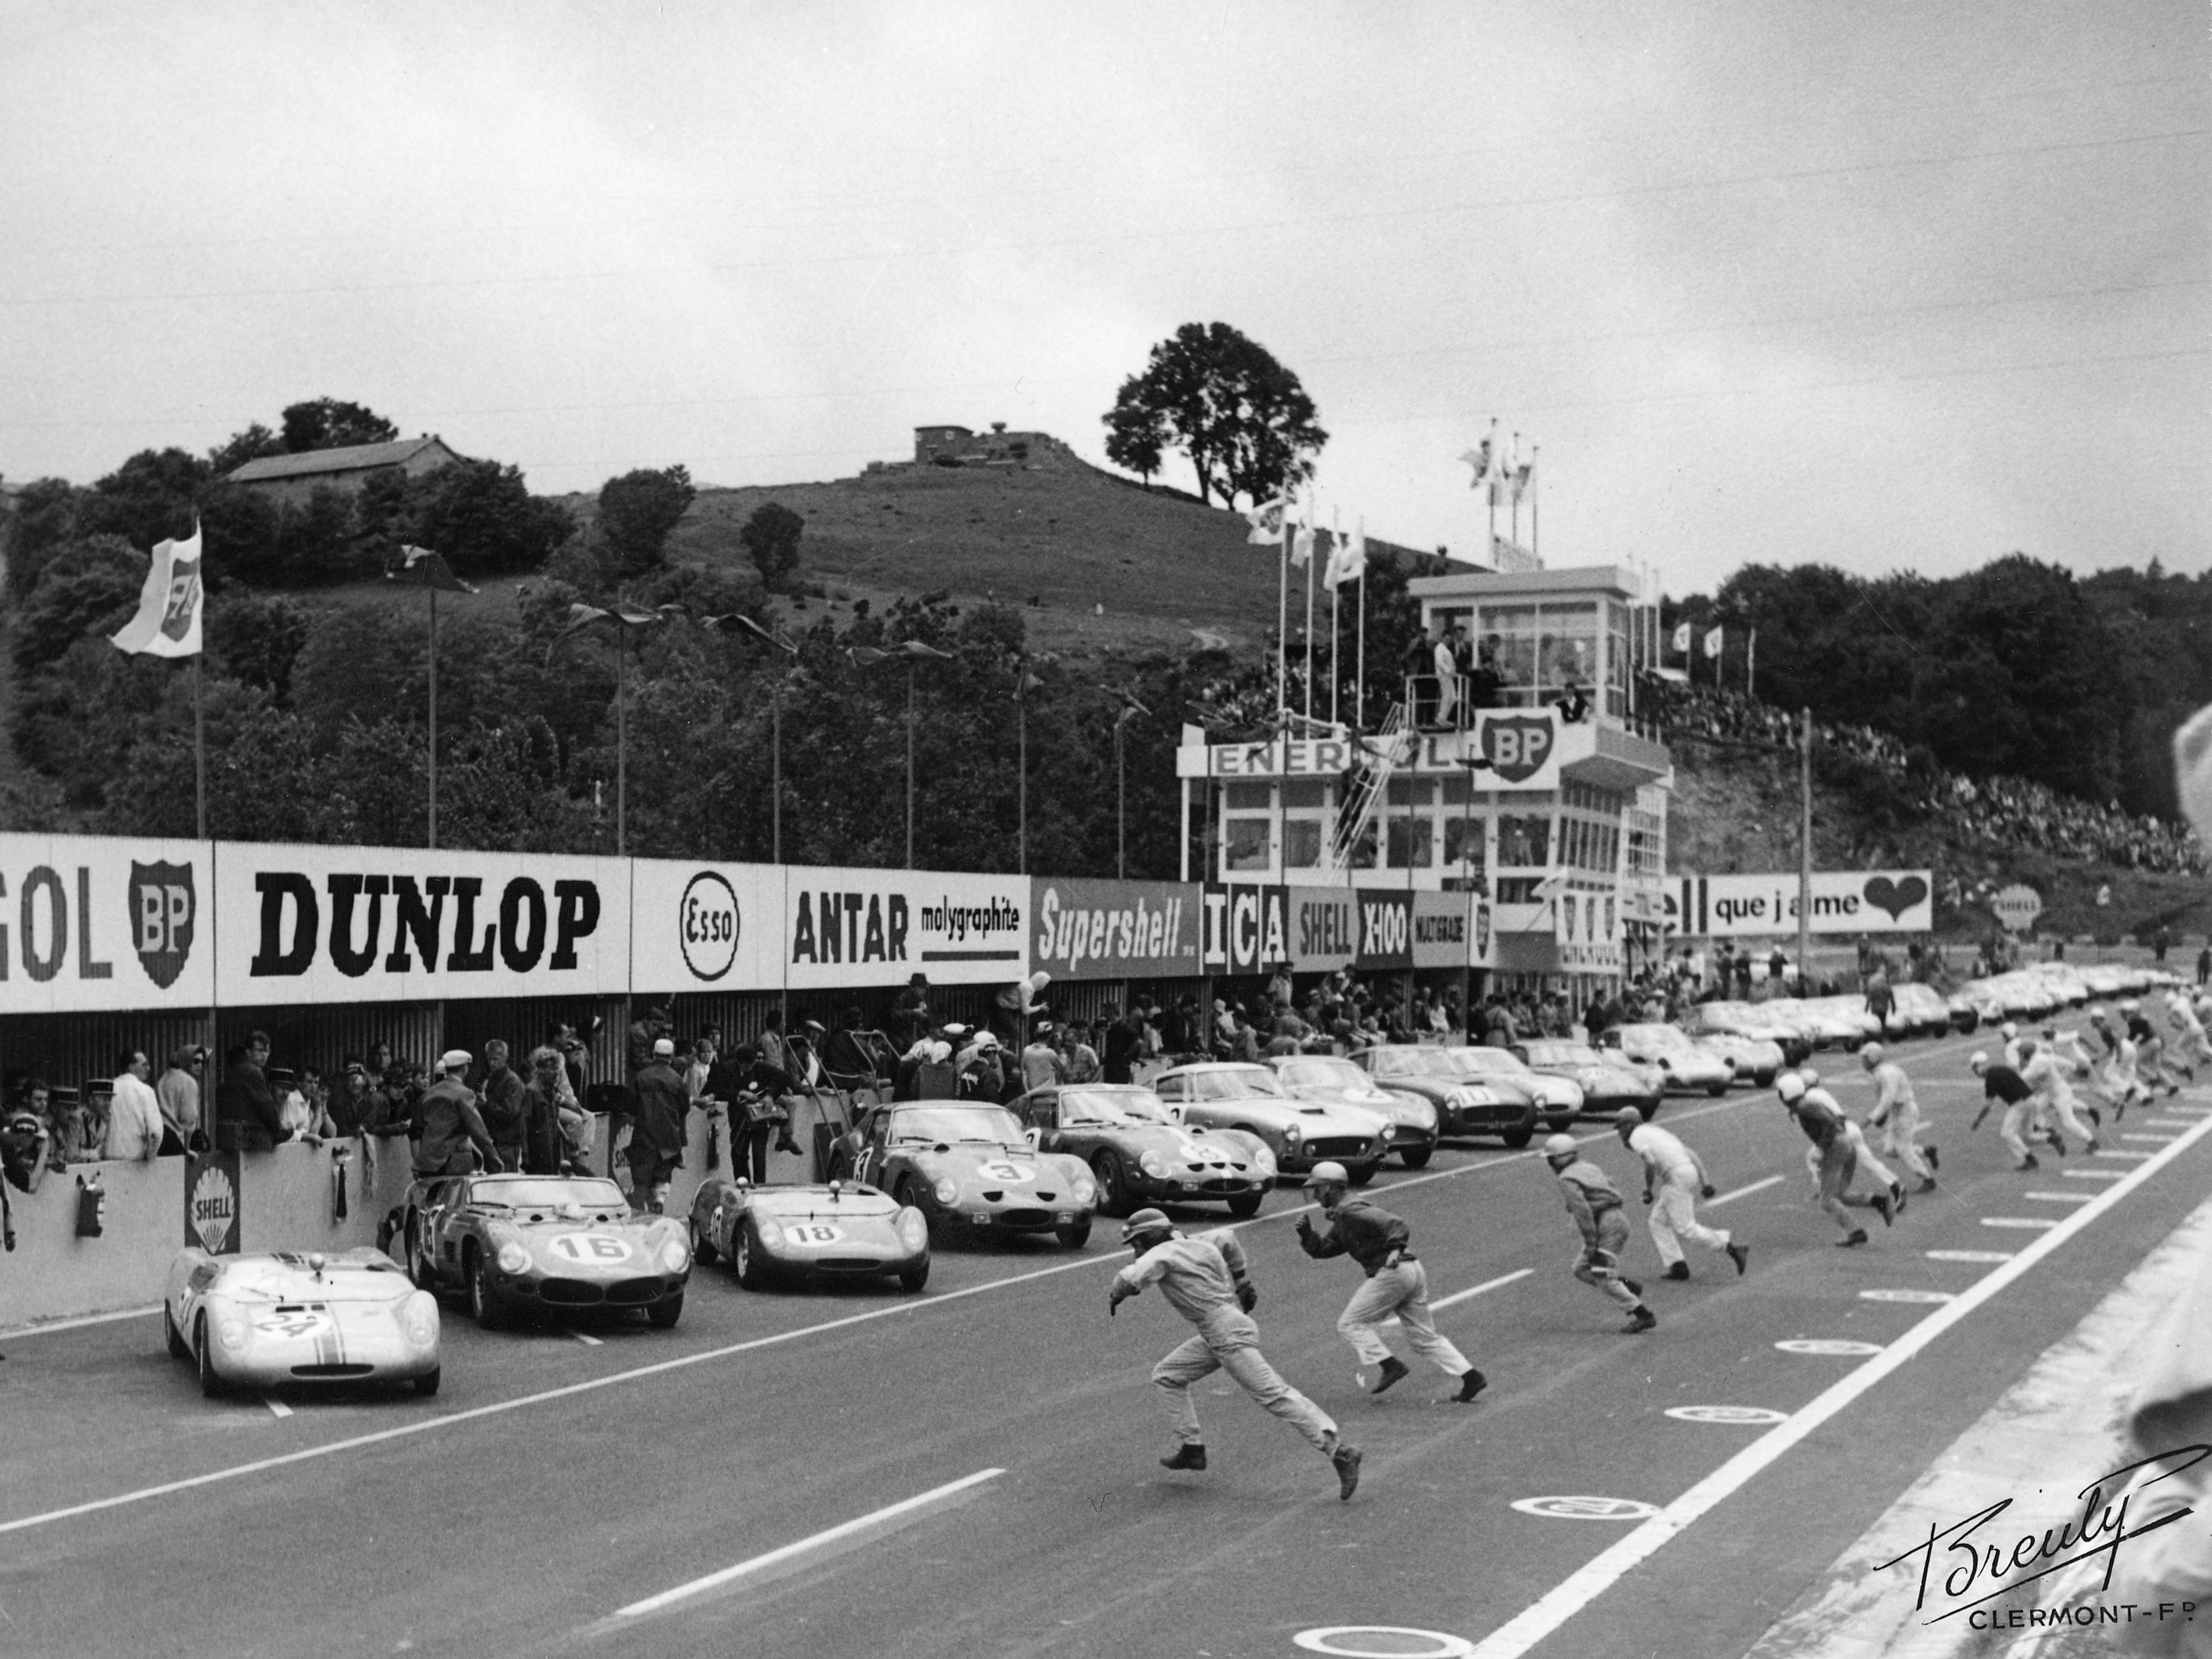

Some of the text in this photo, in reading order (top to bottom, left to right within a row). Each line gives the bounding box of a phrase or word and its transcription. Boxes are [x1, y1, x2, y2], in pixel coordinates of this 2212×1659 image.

[1493, 727, 1548, 766] BP
[0, 865, 113, 982] OL
[138, 884, 190, 953] BP
[250, 871, 601, 978] DUNLOP
[686, 897, 733, 943] Esso
[792, 890, 1021, 964] ANTAR molygraphite
[1039, 887, 1182, 971] Supershell
[1299, 901, 1352, 957] SHELL
[1715, 897, 1766, 925] que
[989, 1164, 1021, 1180] 3
[197, 1196, 232, 1223] SHELL
[557, 1238, 626, 1259] 16
[794, 1226, 836, 1243] 18
